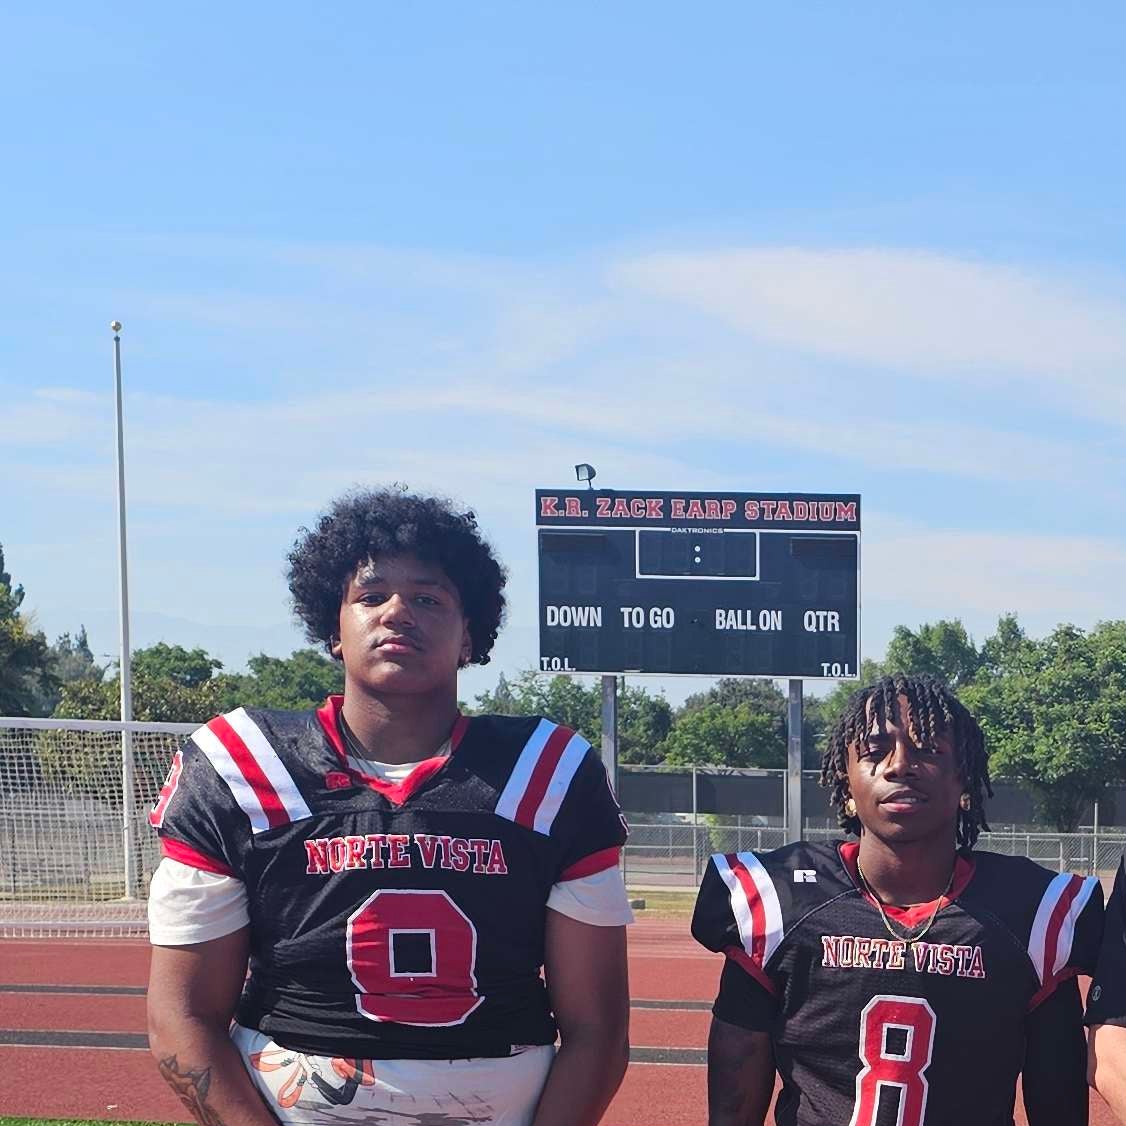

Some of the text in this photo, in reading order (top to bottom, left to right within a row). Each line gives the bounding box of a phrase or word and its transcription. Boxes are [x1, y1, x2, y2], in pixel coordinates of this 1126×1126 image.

[540, 497, 857, 522] K.R. ZACK EARP STADIUM
[546, 605, 602, 628] DOWN
[620, 607, 675, 629] TO GO
[715, 609, 783, 632] BALL ON
[803, 610, 841, 633] QTR
[303, 833, 509, 876] NORTE VISTA
[821, 935, 986, 980] NORTE VISTA
